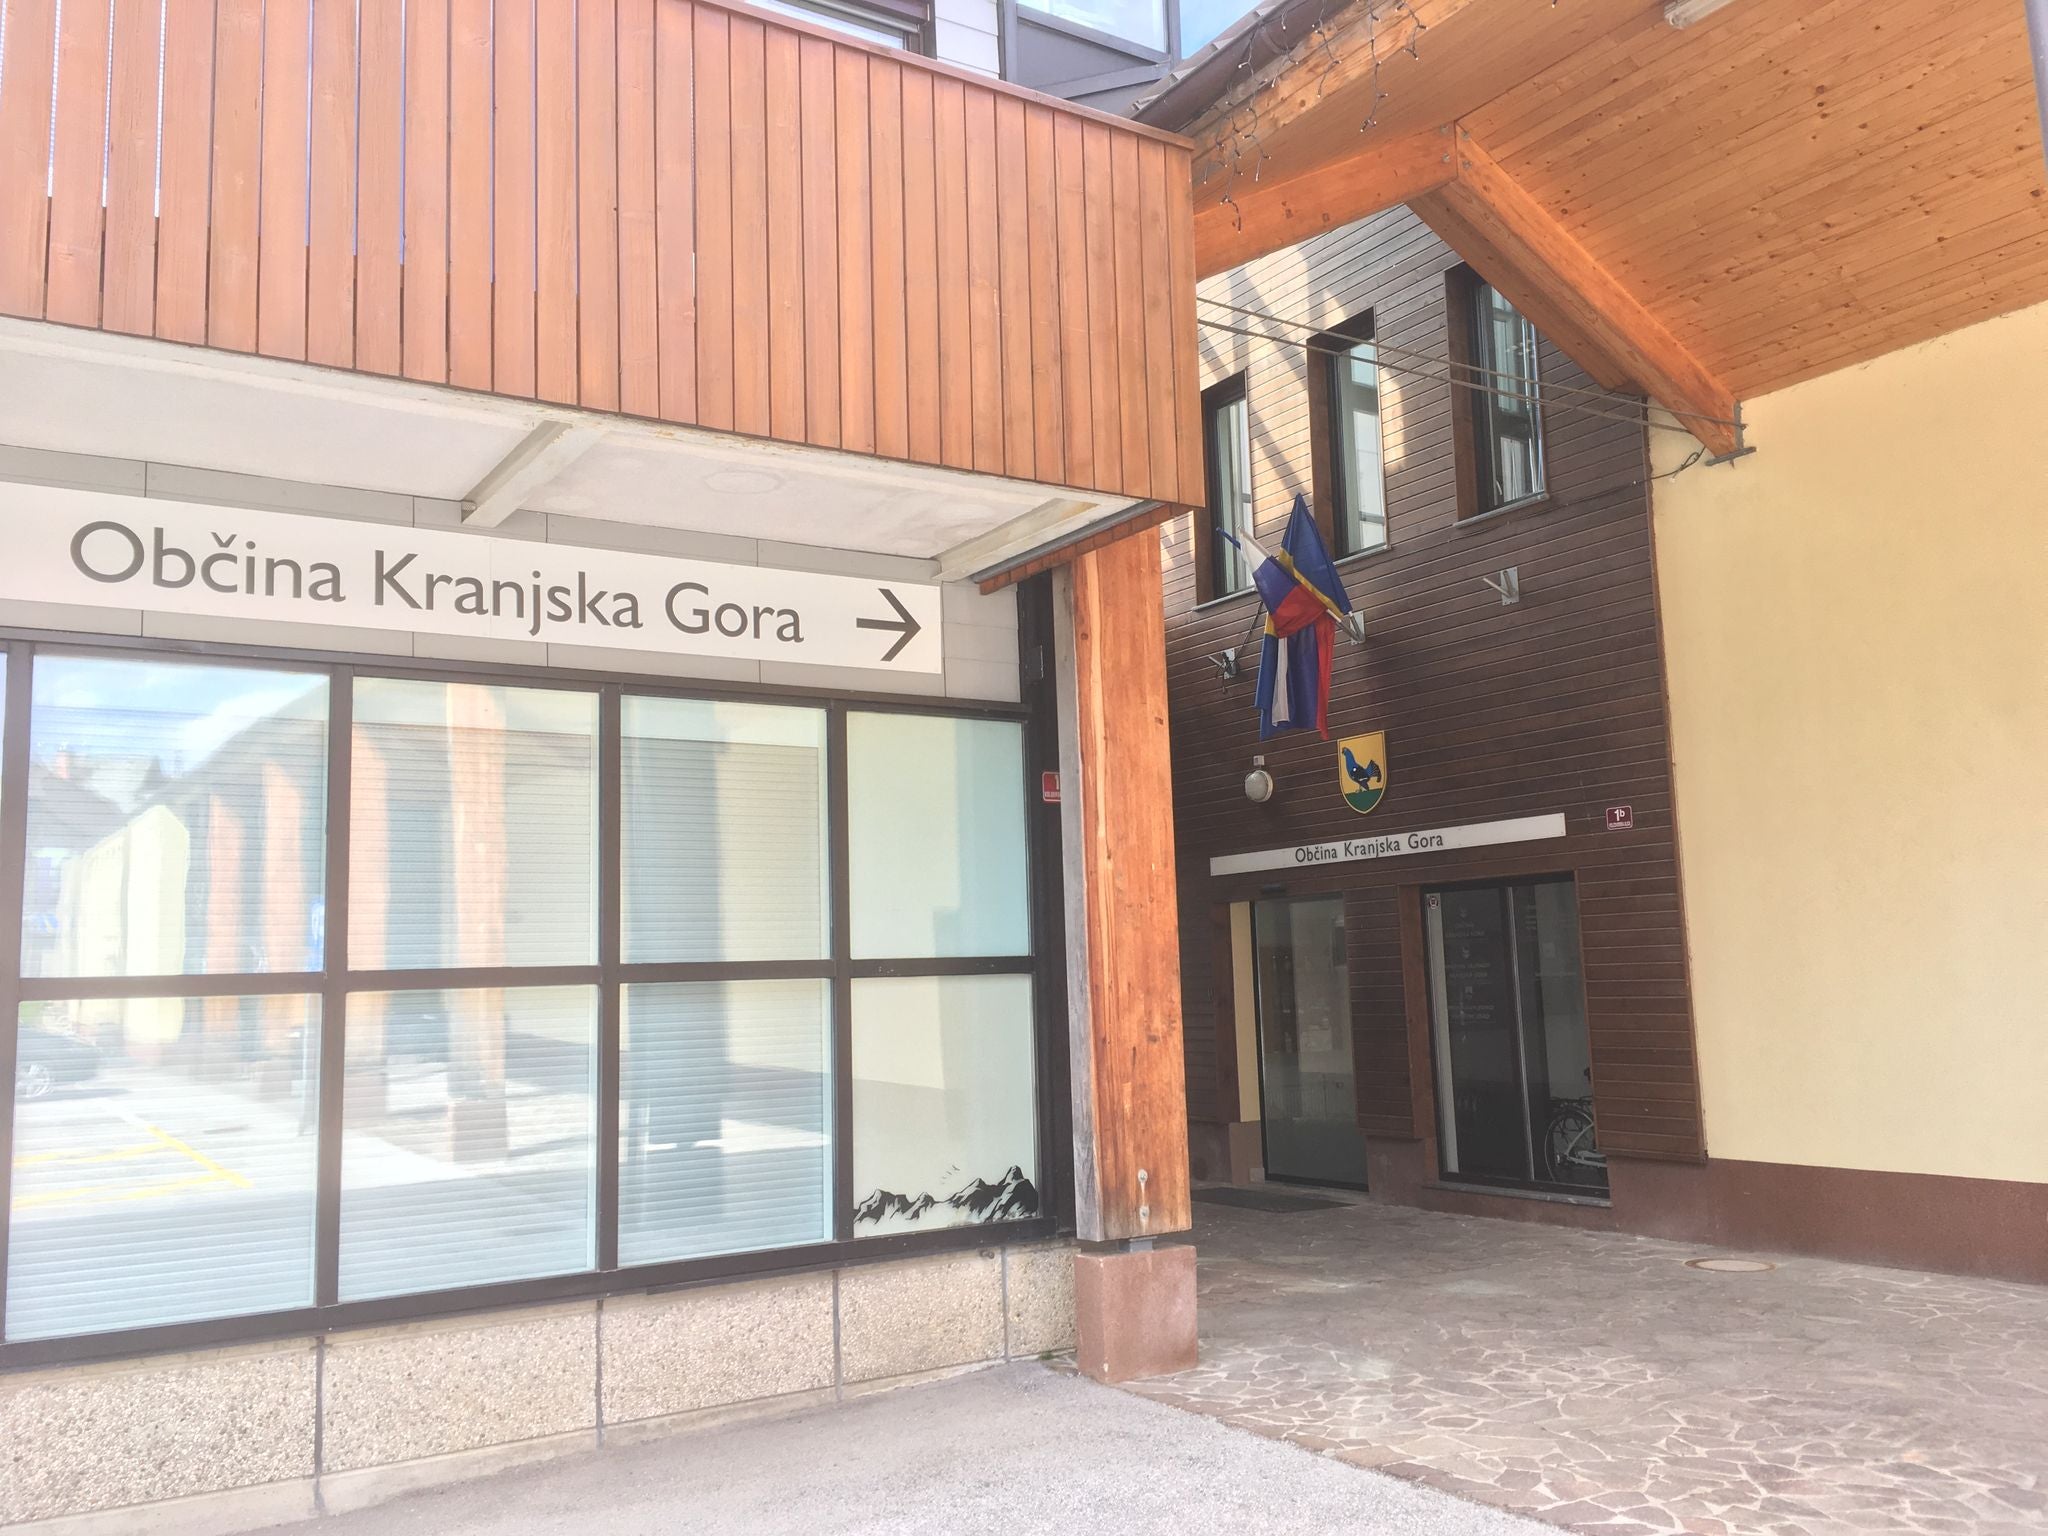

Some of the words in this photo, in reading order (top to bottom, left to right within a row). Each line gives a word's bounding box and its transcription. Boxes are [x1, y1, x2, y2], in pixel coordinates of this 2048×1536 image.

[70, 520, 346, 602] Občina
[375, 549, 644, 636] Kranjska
[665, 582, 805, 643] Gora
[1294, 845, 1338, 863] Občina
[1343, 837, 1401, 859] Kranjska
[1407, 833, 1444, 850] Gora
